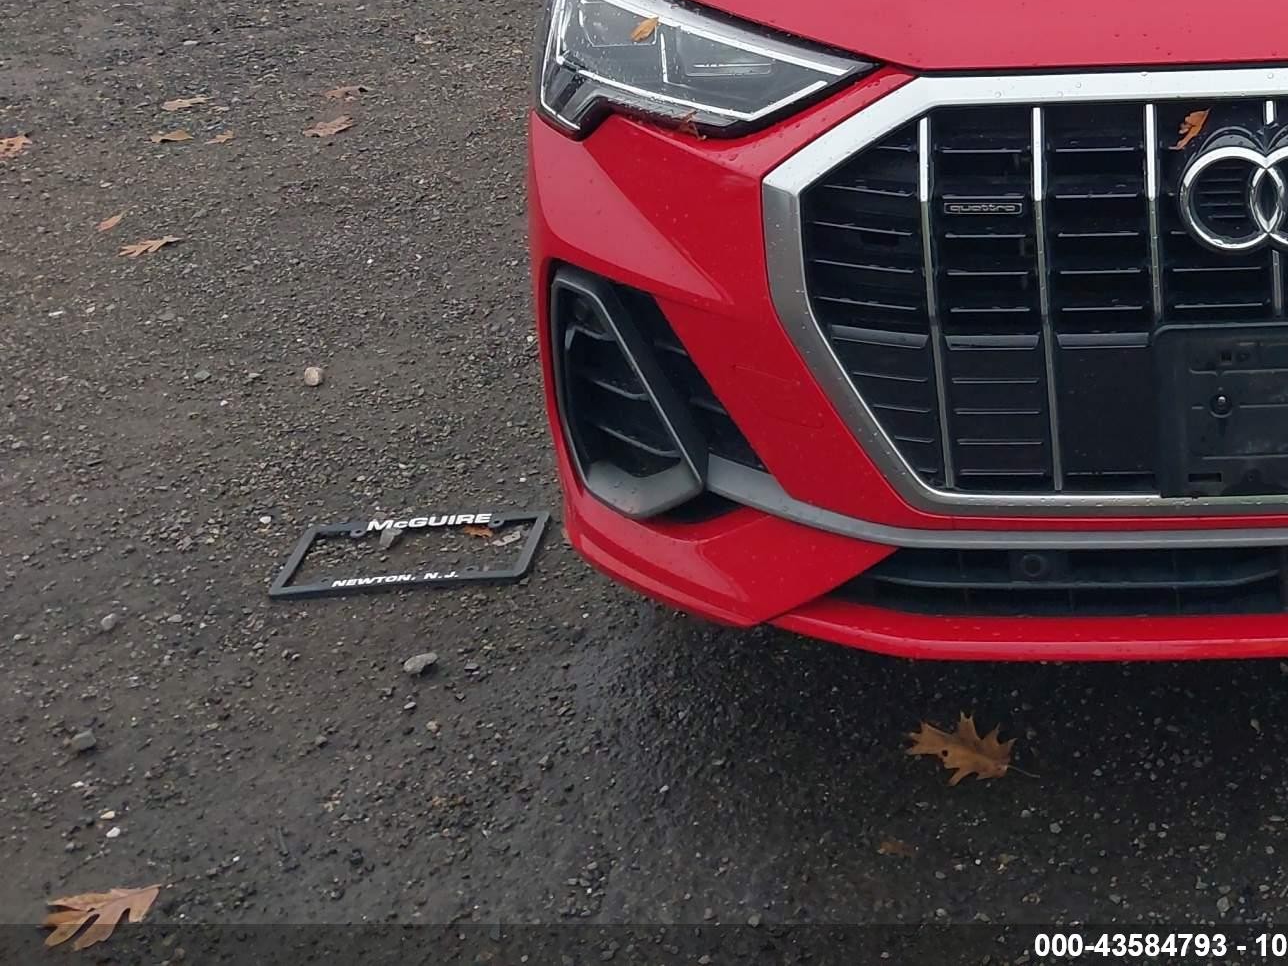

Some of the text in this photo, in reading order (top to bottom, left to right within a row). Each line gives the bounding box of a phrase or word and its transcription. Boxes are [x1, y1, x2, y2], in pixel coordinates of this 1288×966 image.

[949, 204, 1016, 213] quattro
[366, 513, 492, 531] McGUIRE
[423, 571, 459, 580] N.J.
